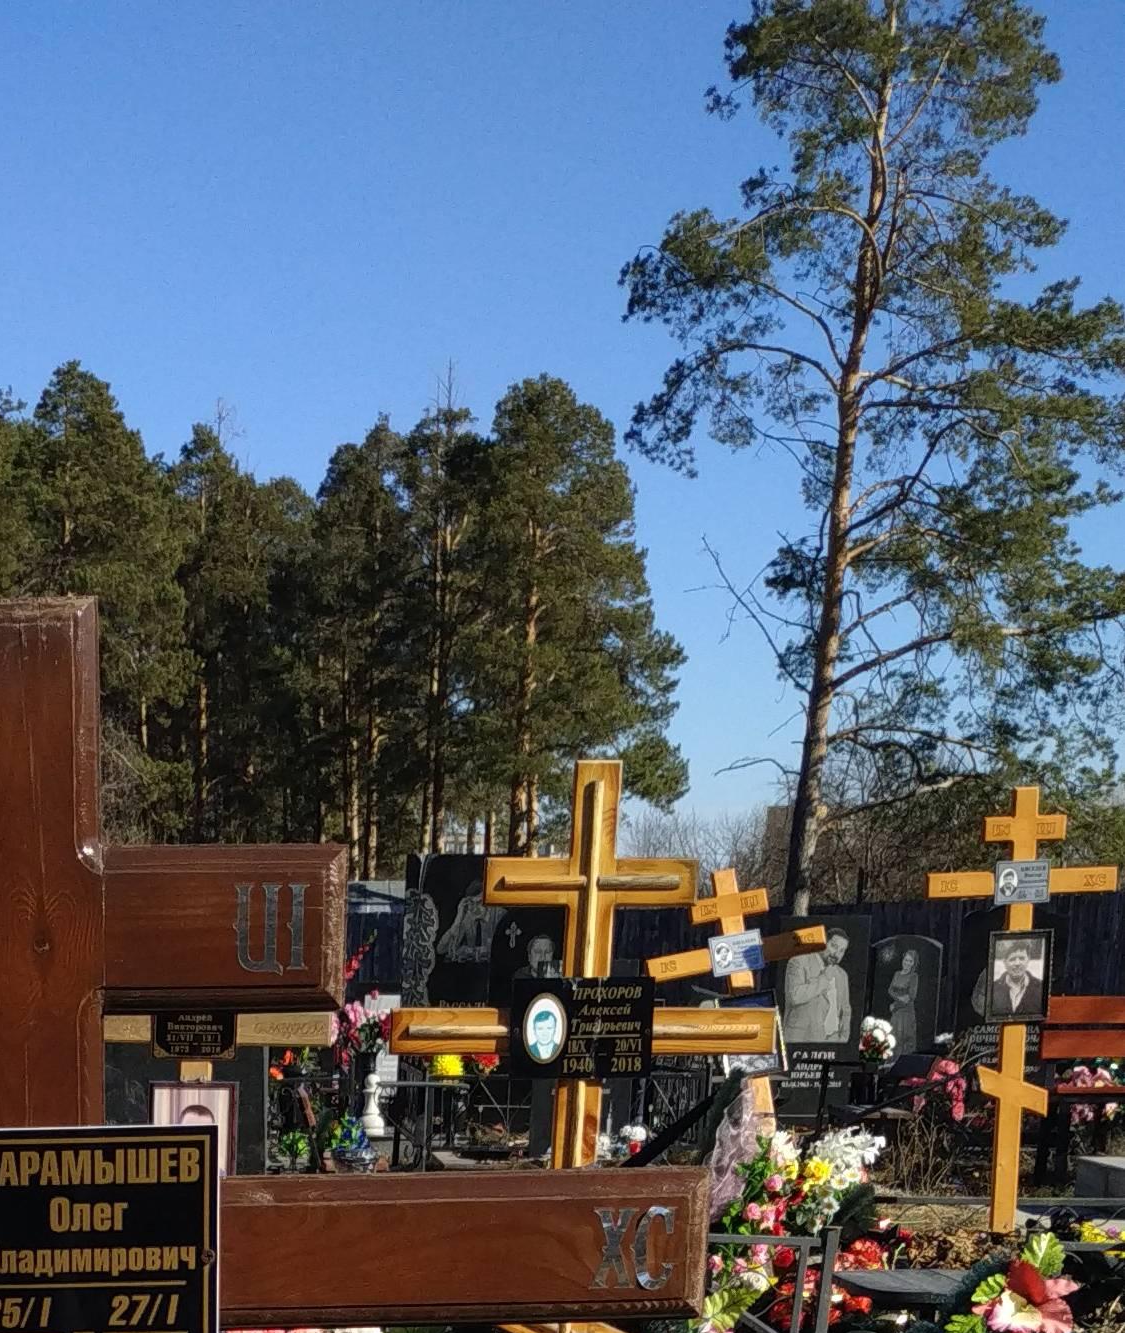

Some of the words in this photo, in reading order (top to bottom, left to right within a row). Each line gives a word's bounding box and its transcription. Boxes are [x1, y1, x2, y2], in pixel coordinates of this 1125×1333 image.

[573, 986, 643, 1000] ПРОХОРОВ
[578, 1003, 632, 1016] Алексей
[611, 1057, 642, 1073] 2018
[49, 1196, 129, 1233] Олег
